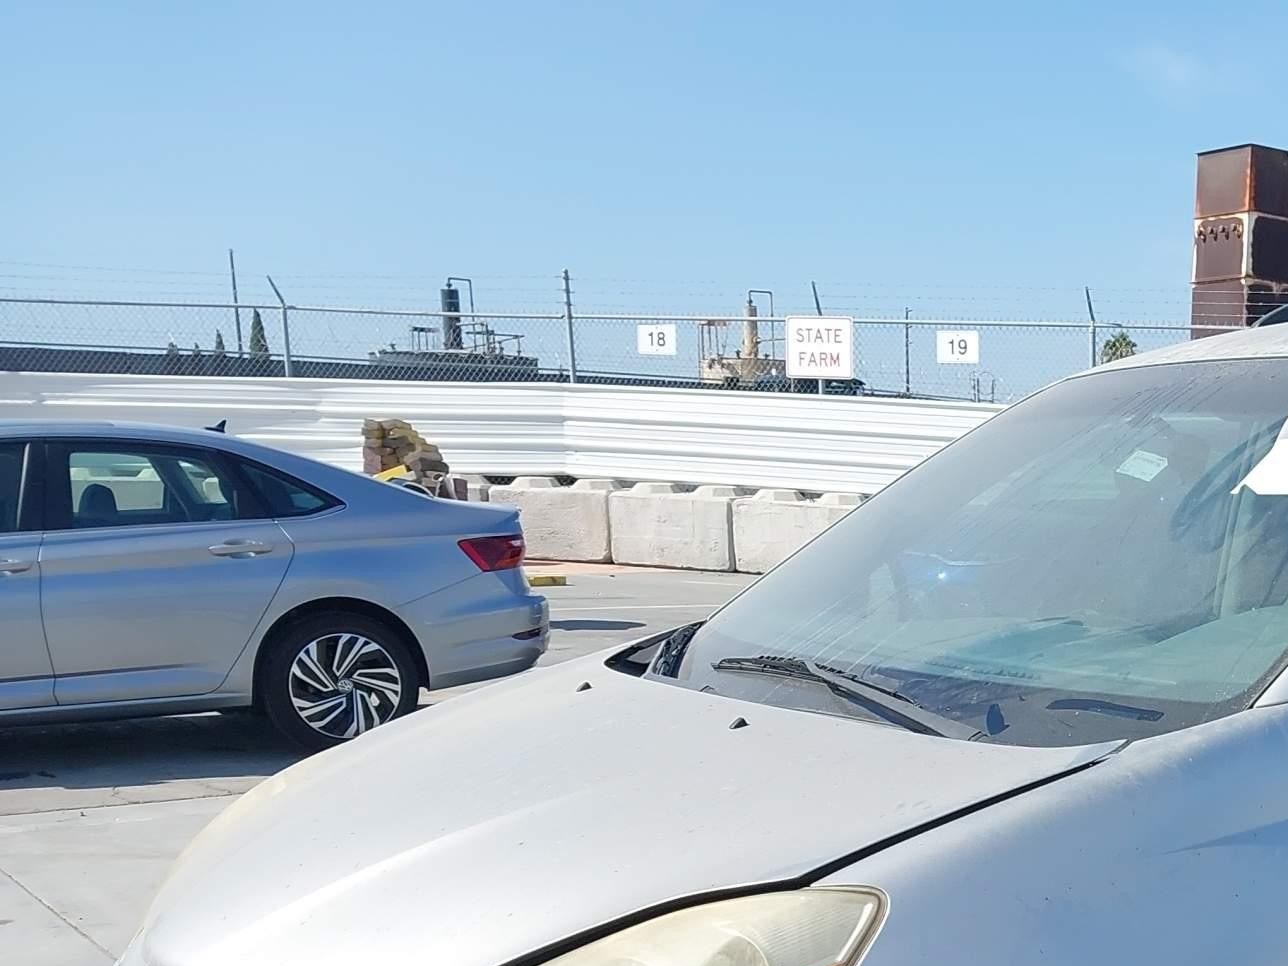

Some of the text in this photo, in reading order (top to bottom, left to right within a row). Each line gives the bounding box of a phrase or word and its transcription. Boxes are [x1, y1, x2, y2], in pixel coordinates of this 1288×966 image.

[647, 331, 666, 347] 18
[795, 327, 843, 344] STATE
[947, 338, 968, 355] 19
[798, 351, 841, 368] FARM
